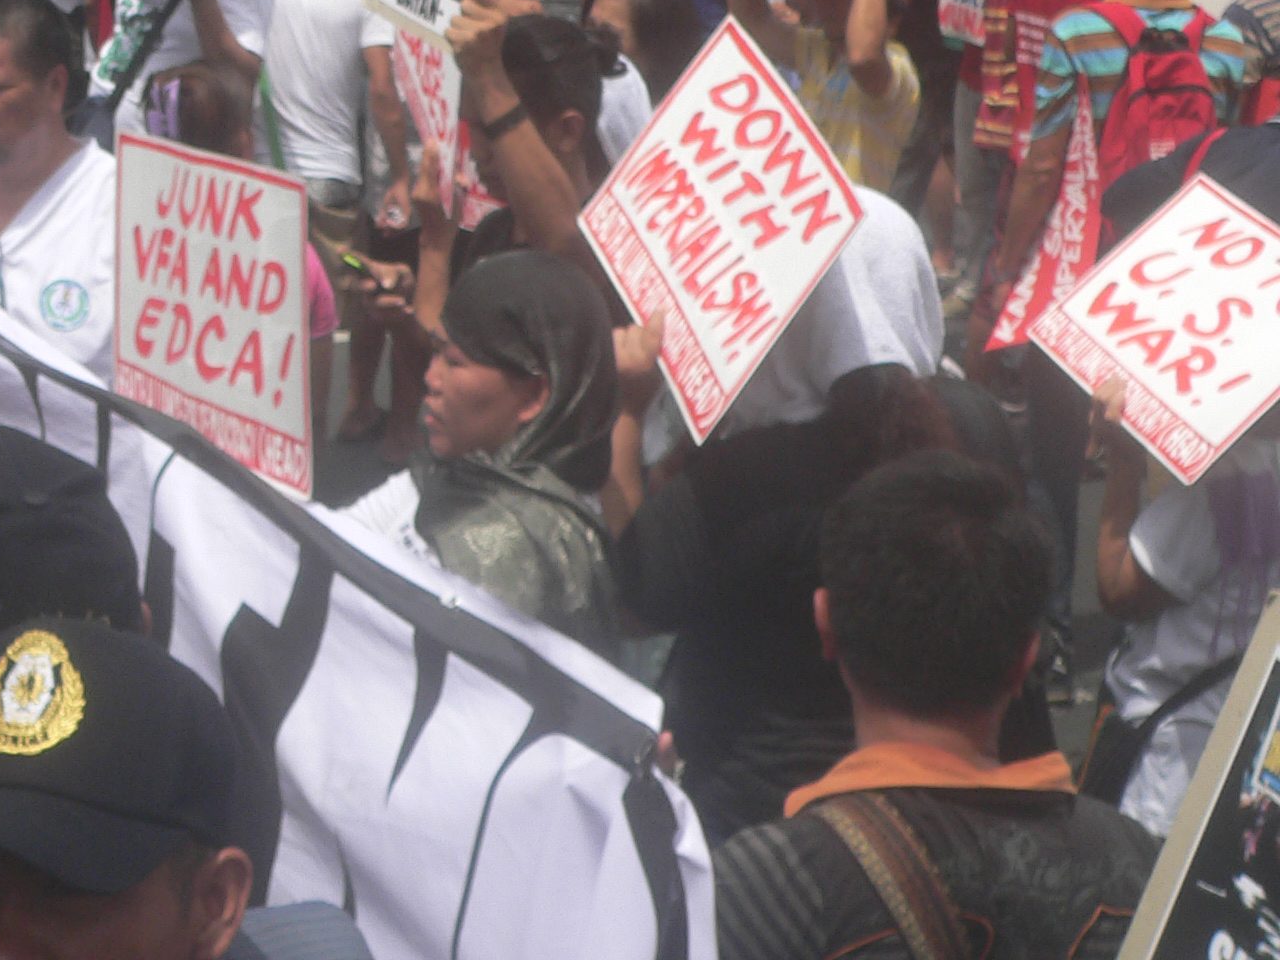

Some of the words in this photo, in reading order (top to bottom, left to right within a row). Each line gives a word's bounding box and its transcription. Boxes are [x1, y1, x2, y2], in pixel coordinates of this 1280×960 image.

[157, 165, 264, 242] JUNK
[680, 110, 790, 251] WITH
[709, 73, 843, 246] DOWN
[133, 223, 189, 299] VFA
[199, 246, 288, 316] AND
[622, 138, 779, 367] IMPERIALISM!
[1128, 249, 1255, 348] U.S.
[1178, 216, 1266, 271] NO
[133, 296, 297, 410] EDCA!
[1086, 279, 1253, 408] WAR!
